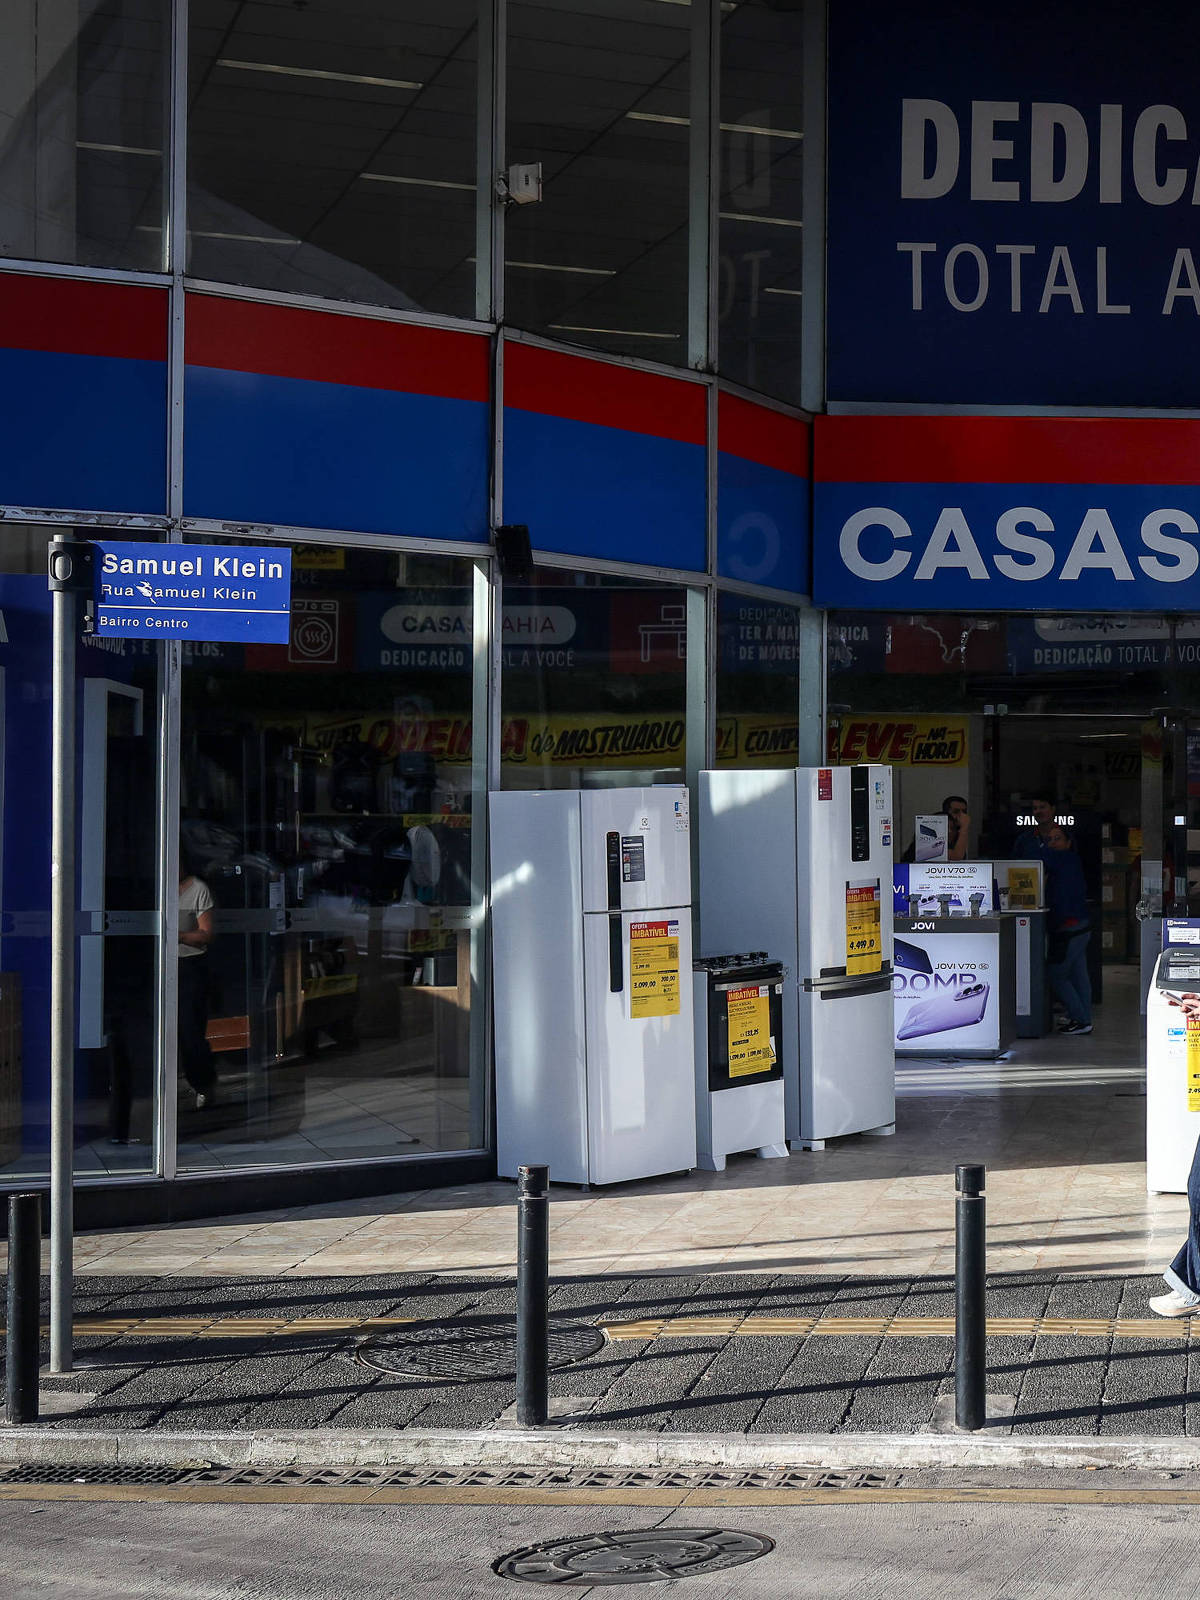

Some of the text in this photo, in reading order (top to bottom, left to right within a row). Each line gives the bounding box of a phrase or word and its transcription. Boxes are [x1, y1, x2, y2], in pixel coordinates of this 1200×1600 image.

[897, 242, 1131, 315] TOTAL
[102, 553, 283, 579] Samuel Klein
[102, 584, 134, 597] Rua
[213, 588, 256, 600] Klein
[100, 616, 189, 629] Bairro Centro
[402, 616, 556, 634] CASAAHIA
[738, 626, 762, 641] TER
[381, 649, 465, 669] DEDICAÇÃO
[738, 646, 756, 661] DE
[1033, 644, 1113, 667] DEDICAÇÃO
[1118, 646, 1159, 665] TOTAL
[368, 719, 529, 757] QUEIA
[555, 720, 685, 757] MOSTRUÁRIO
[744, 724, 800, 752] COMP
[1016, 815, 1075, 826] SAMNG
[893, 885, 905, 894] VI
[631, 927, 667, 938] IMBATÍVEL
[911, 922, 935, 930] JOVI
[728, 988, 759, 1001] IMBATÍVEL
